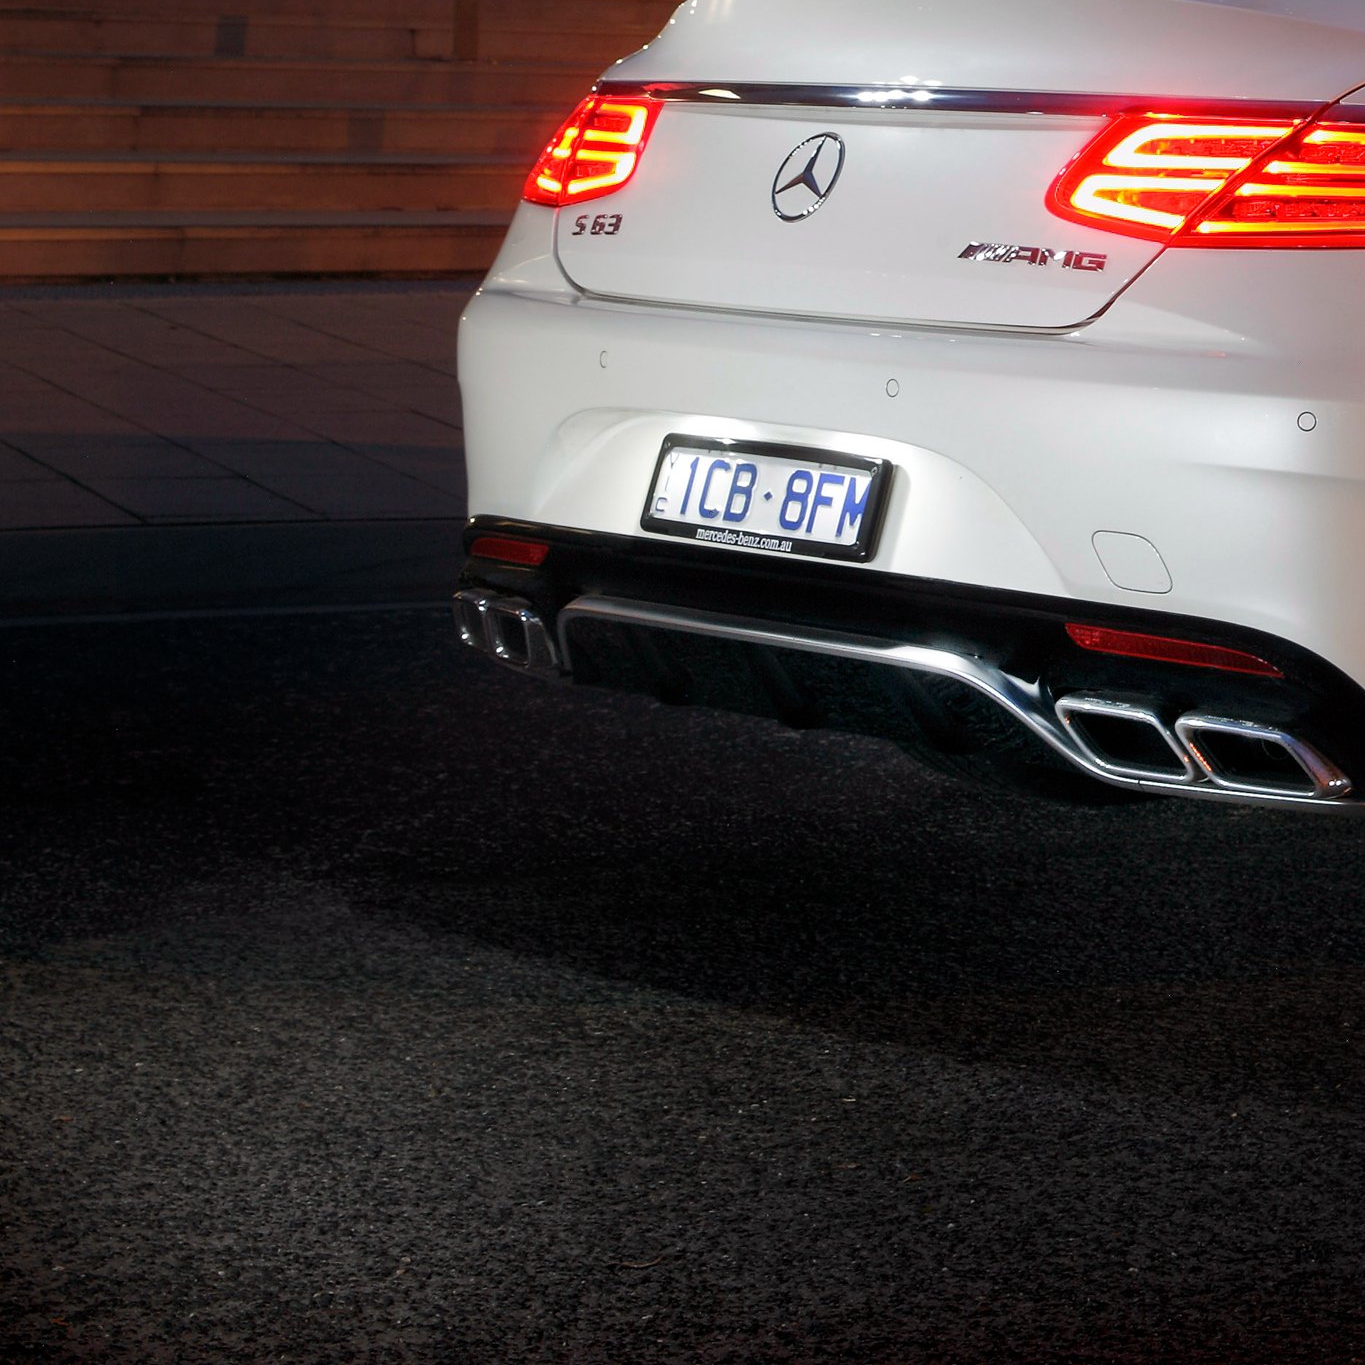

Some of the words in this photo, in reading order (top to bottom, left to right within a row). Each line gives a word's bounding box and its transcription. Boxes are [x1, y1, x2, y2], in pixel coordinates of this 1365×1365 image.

[572, 214, 590, 236] S
[590, 214, 624, 236] 63
[1001, 244, 1108, 272] AMG
[695, 527, 793, 553] mercedes-benz.com.au
